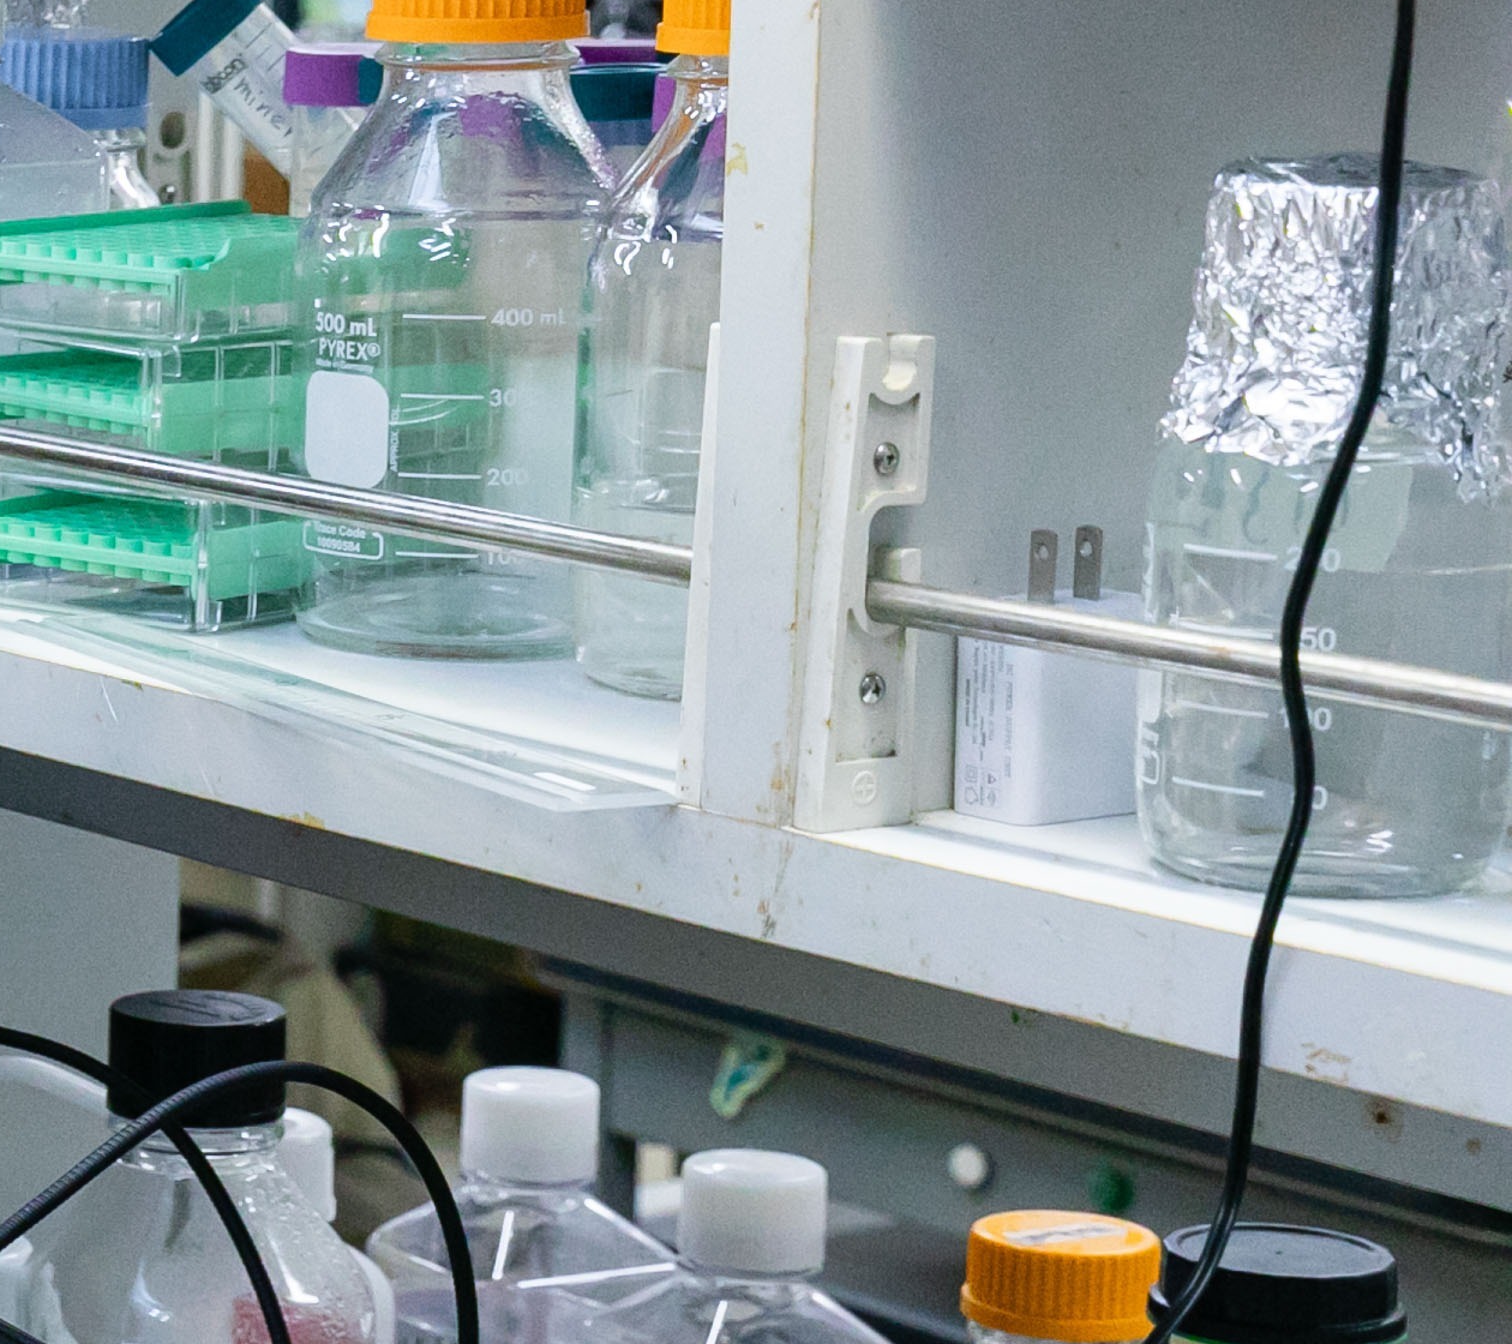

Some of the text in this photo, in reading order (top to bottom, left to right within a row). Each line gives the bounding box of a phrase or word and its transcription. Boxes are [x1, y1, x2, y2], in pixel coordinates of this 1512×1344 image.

[315, 311, 378, 337] 500 mL
[490, 308, 534, 328] 400
